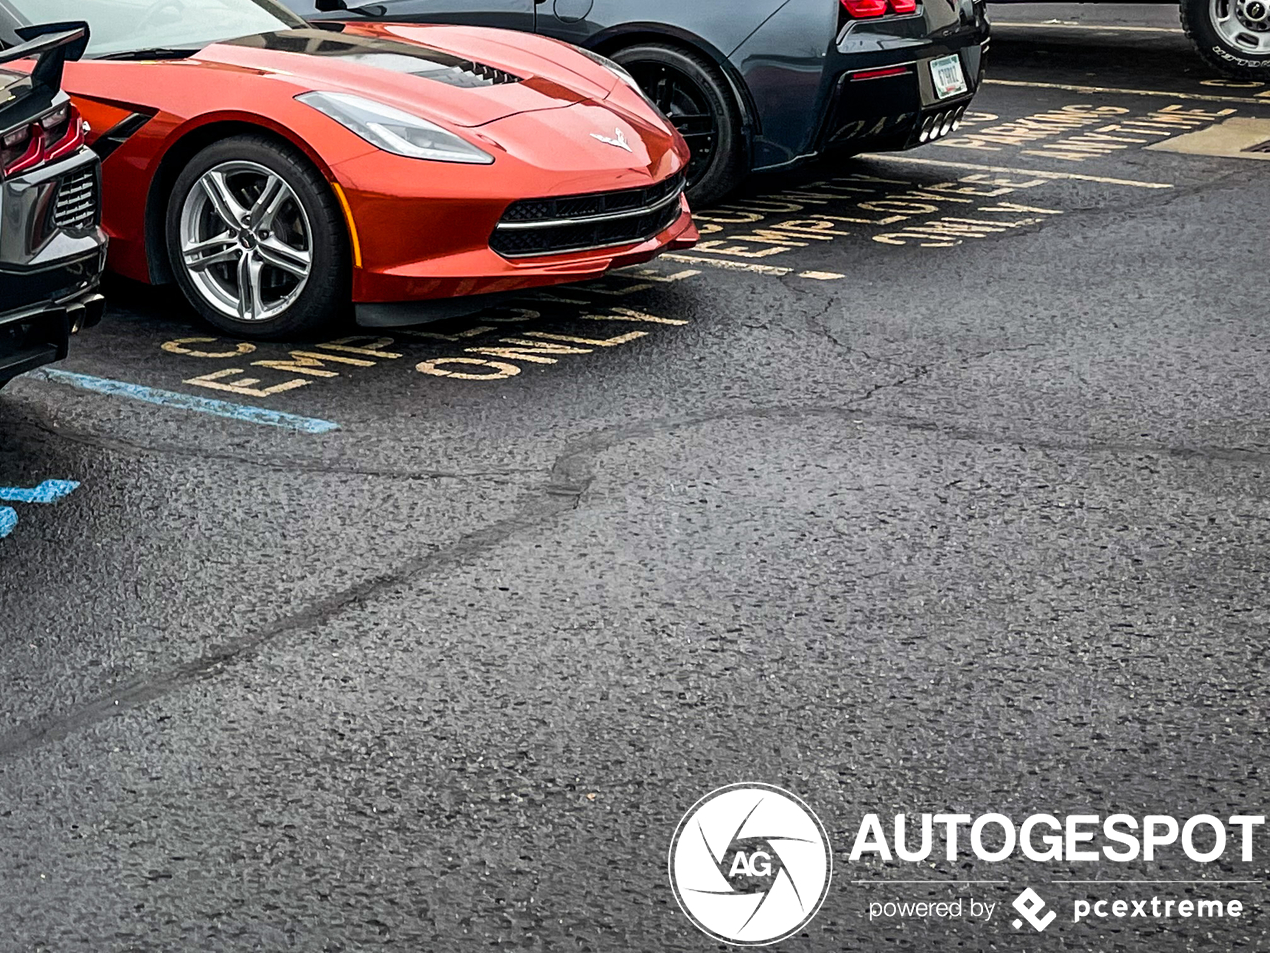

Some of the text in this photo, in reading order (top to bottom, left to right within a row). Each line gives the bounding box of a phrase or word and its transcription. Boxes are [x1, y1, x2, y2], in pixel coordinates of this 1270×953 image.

[931, 104, 1129, 151] PARKING
[1019, 103, 1238, 162] ANYTIME
[689, 173, 1050, 258] EMPLOYEE
[871, 201, 1065, 248] ONLY
[415, 307, 690, 381] ONLY
